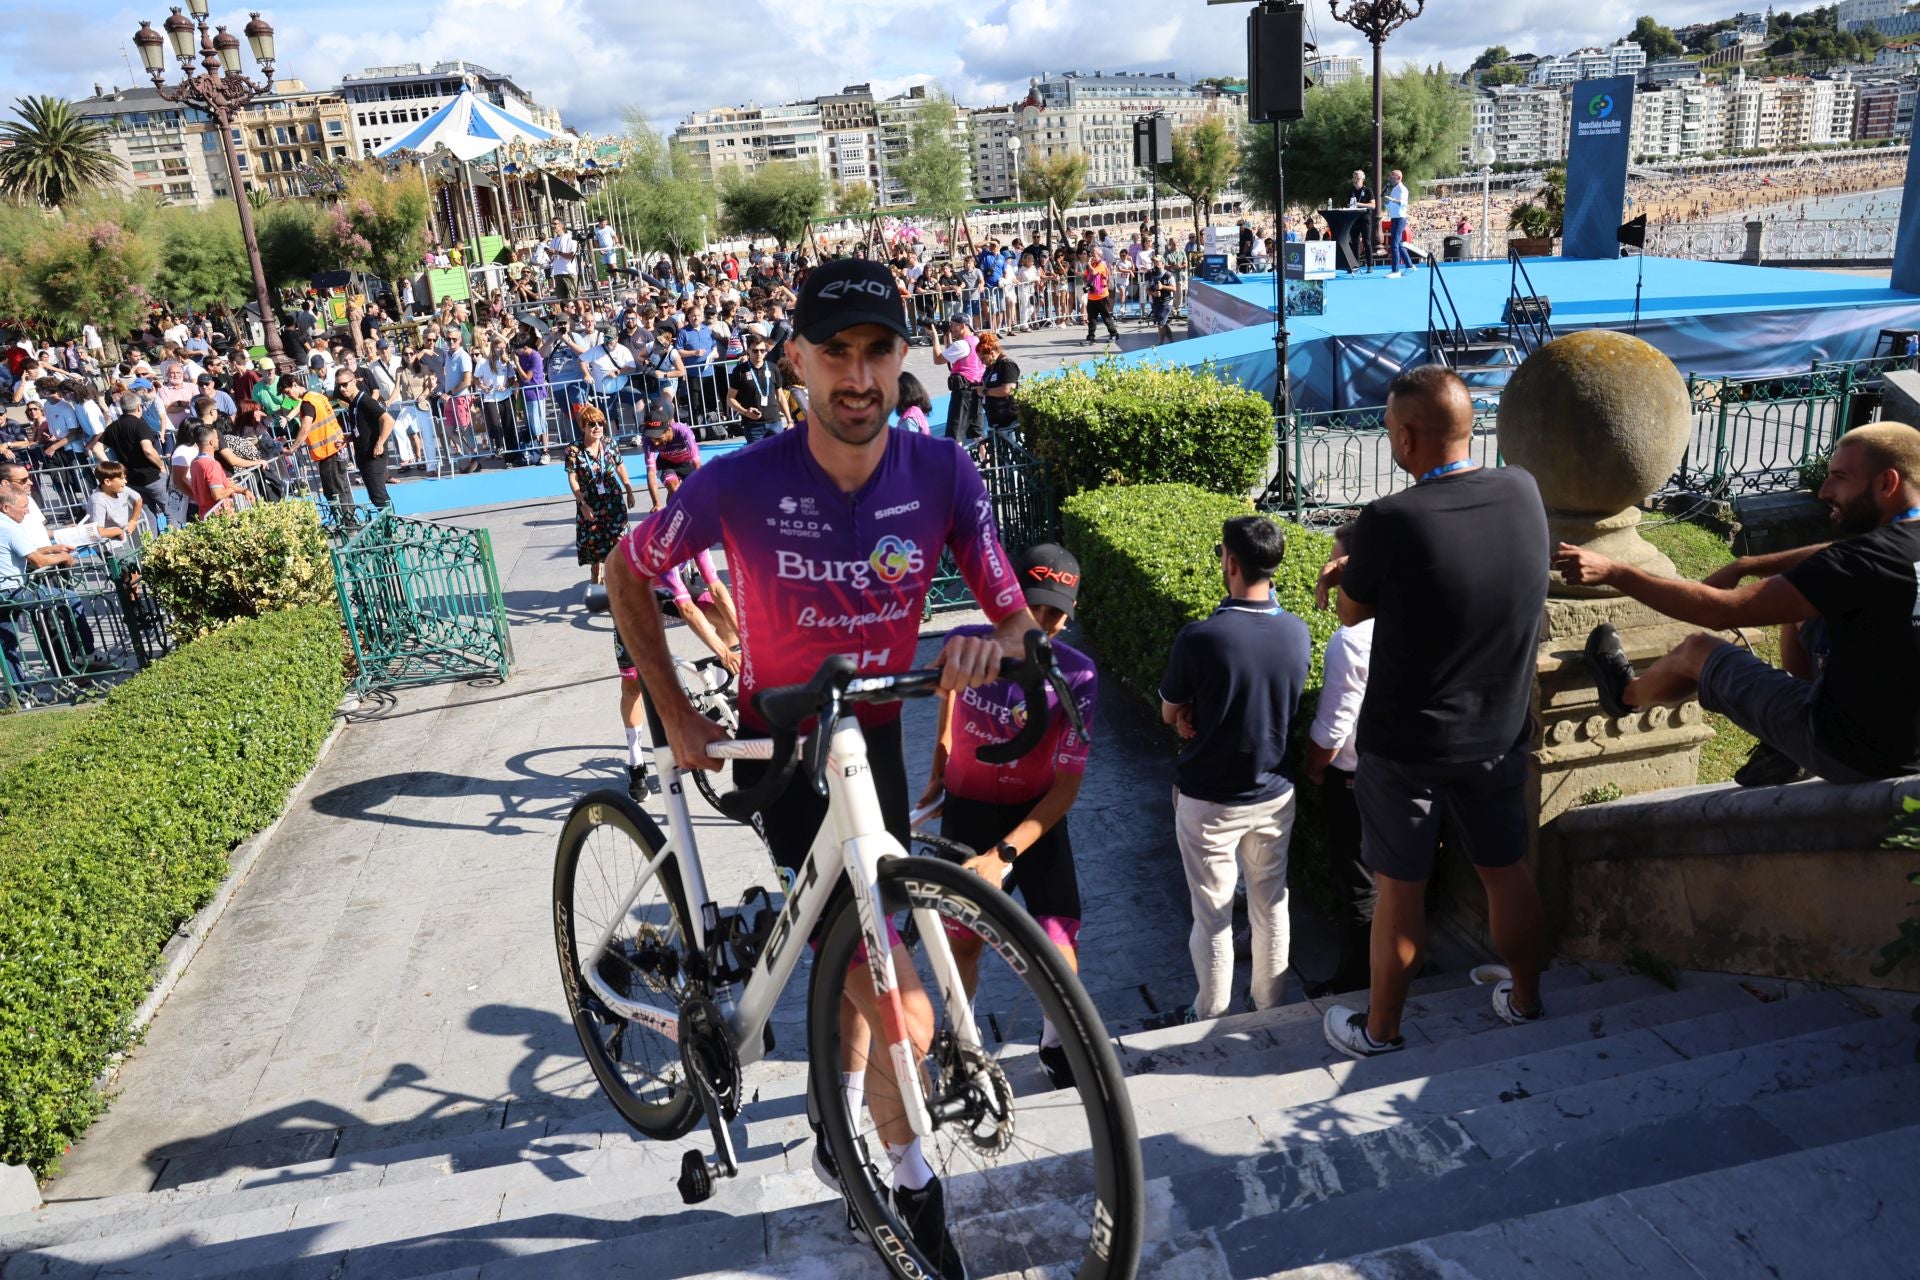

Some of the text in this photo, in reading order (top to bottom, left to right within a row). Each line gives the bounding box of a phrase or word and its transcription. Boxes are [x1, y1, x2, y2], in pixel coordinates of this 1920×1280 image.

[660, 509, 685, 549] CORTIZO
[874, 500, 921, 520] SIROKO
[775, 534, 925, 590] Burgos
[797, 598, 915, 634] Burpellet
[844, 764, 869, 778] BH
[765, 853, 819, 976] BH
[905, 880, 1030, 975] Vision
